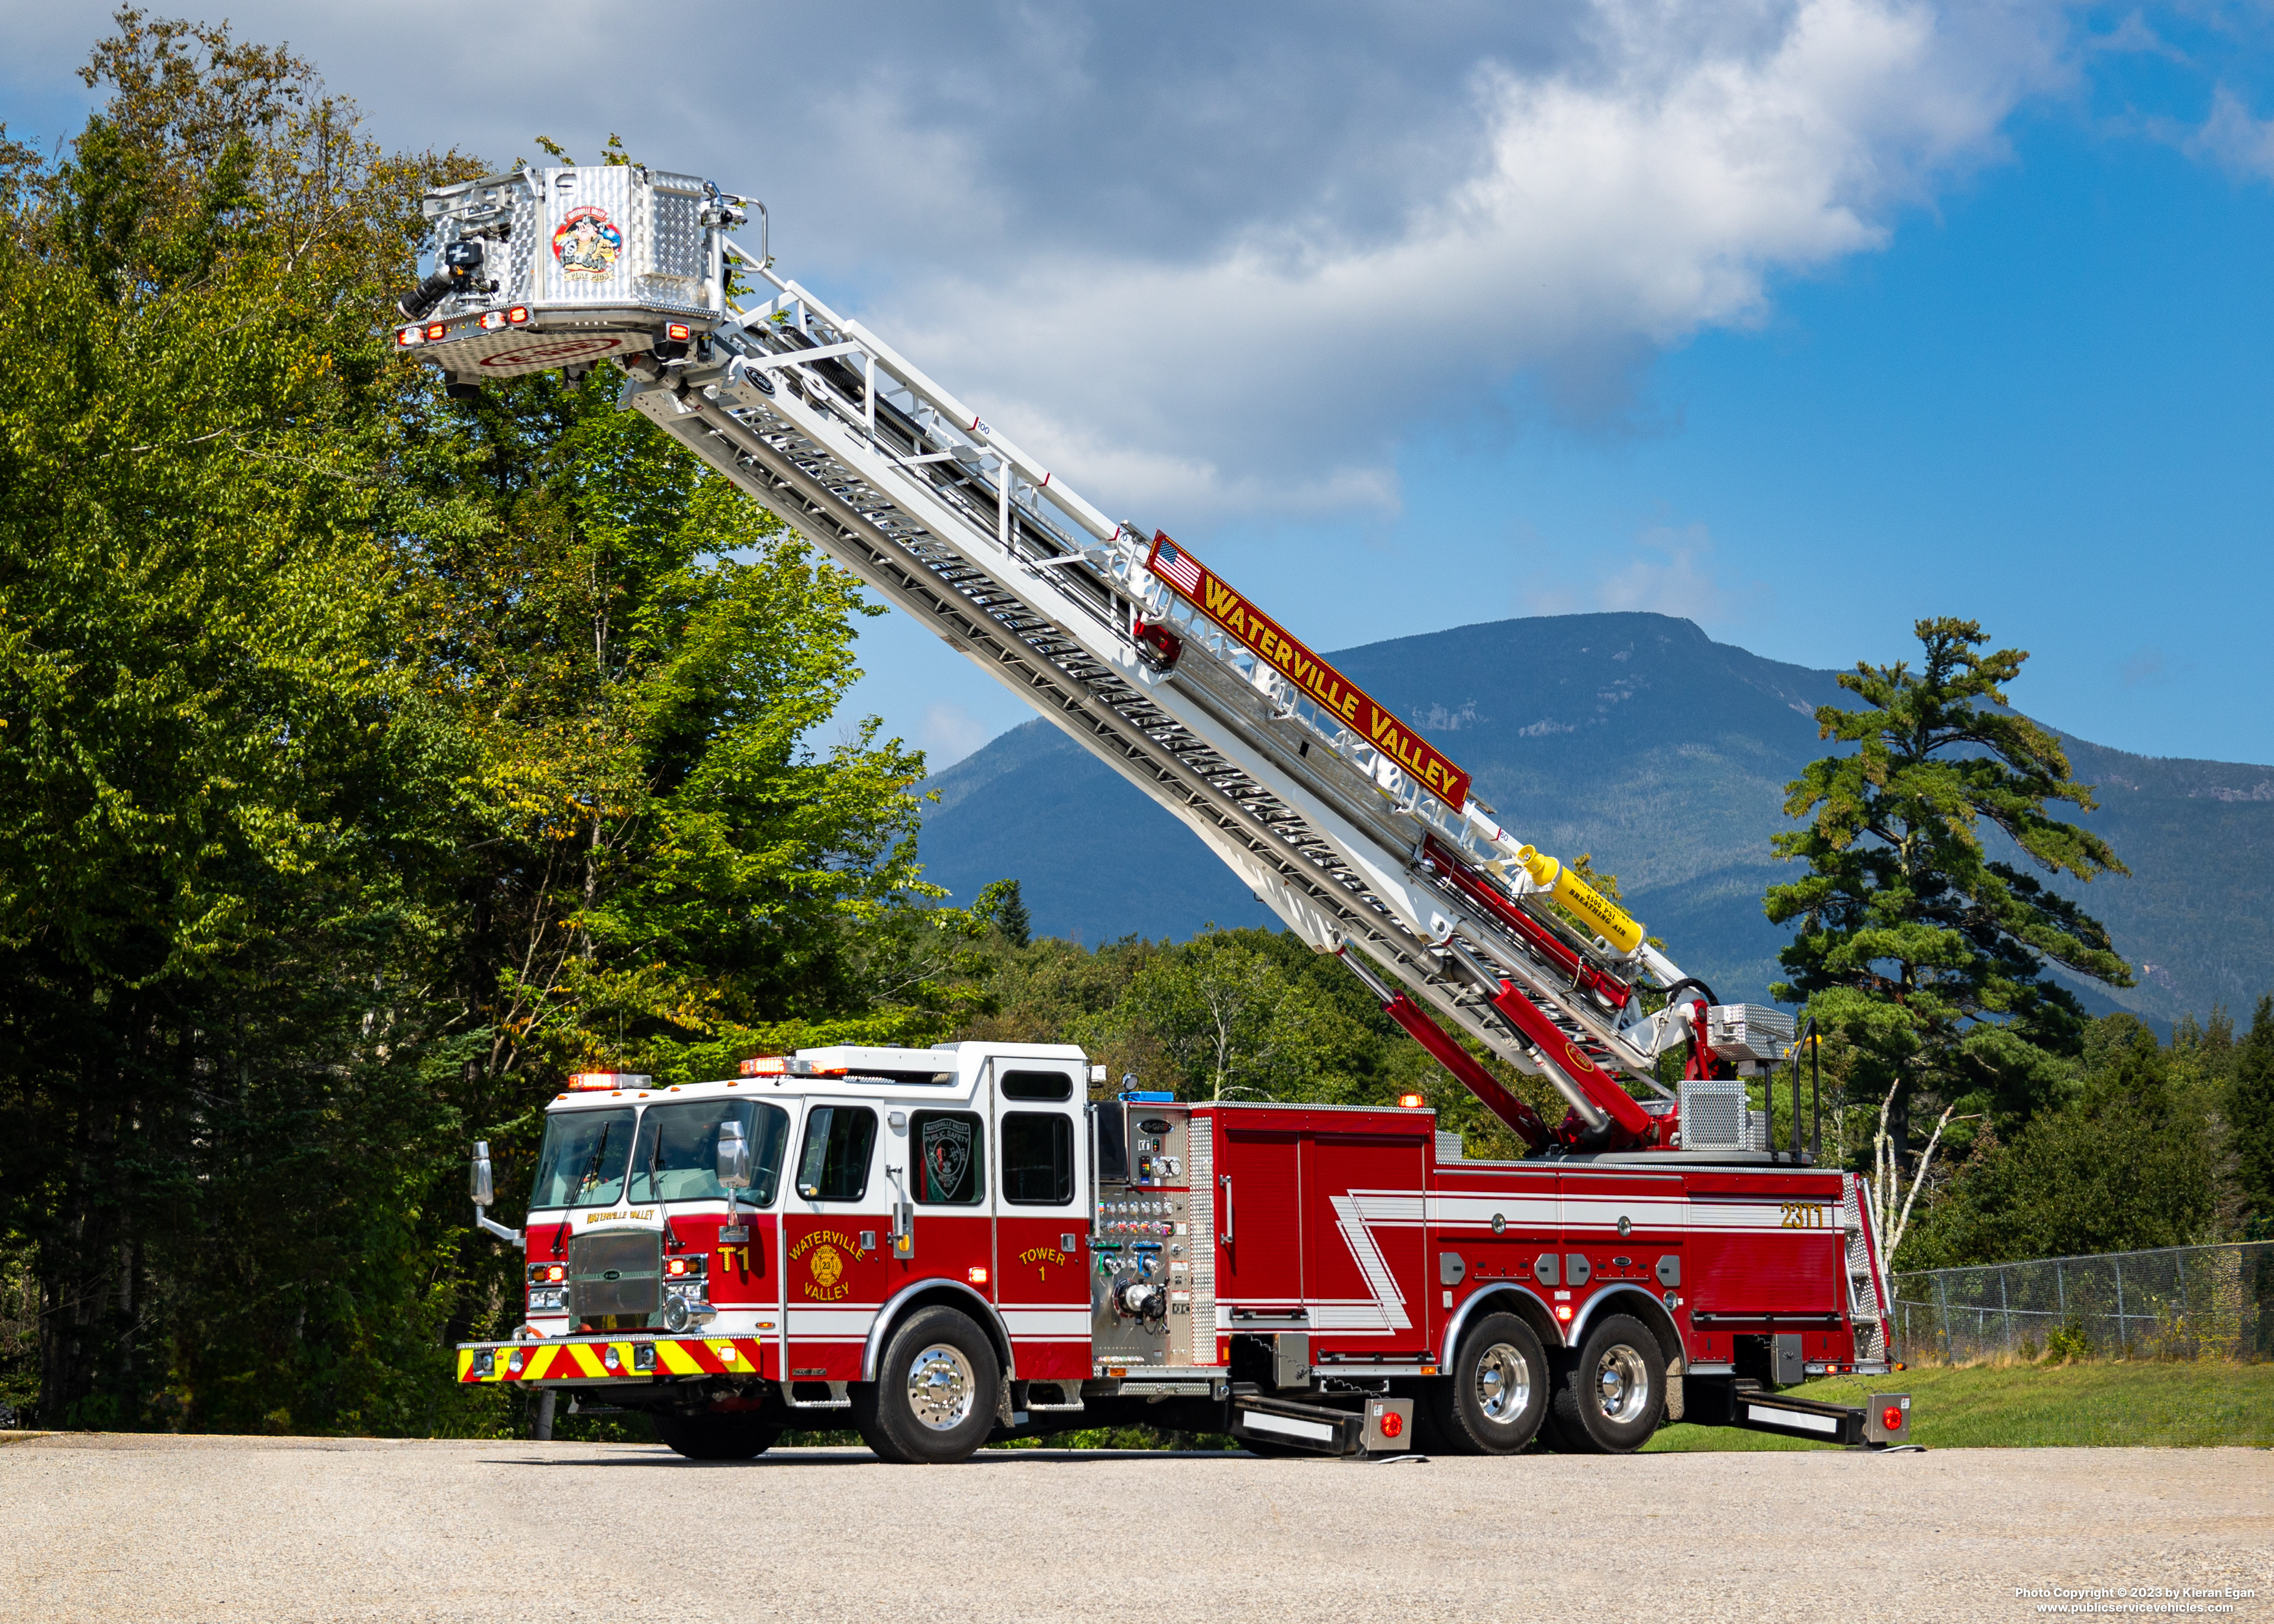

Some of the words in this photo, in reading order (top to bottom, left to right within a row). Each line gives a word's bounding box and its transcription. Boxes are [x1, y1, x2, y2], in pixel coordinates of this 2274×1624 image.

[591, 208, 607, 218] VALLEY
[571, 273, 588, 281] FIRE
[591, 272, 609, 281] PIGS
[503, 342, 599, 363] E-ONE
[751, 371, 771, 389] E-ONE
[978, 421, 990, 434] 100
[1204, 573, 1360, 721] WATERVILLE
[1371, 705, 1458, 796] VALLEY
[1500, 831, 1509, 842] 60
[1574, 876, 1592, 894] HIGH
[1595, 892, 1631, 925] PRESSURE
[1586, 894, 1602, 909] 4500
[1604, 906, 1616, 920] PSI
[1568, 888, 1612, 924] BREATHING
[1612, 922, 1627, 937] AIR
[1569, 1046, 1590, 1068] E-ONE
[926, 1121, 952, 1132] WATERVILLE
[952, 1122, 968, 1132] VALLEY
[1144, 1122, 1168, 1131] E-ONE
[925, 1131, 946, 1143] PUBLIC
[946, 1130, 969, 1143] SAFETY
[938, 1174, 958, 1182] MEDICAL
[587, 1210, 627, 1225] WATERVILLE
[630, 1209, 655, 1221] VALLEY
[1780, 1201, 1824, 1229] 23T1
[788, 1229, 866, 1262] WATERVILLE
[717, 1246, 749, 1273] T1
[822, 1261, 831, 1269] 23
[1019, 1246, 1065, 1268] TOWER
[1038, 1265, 1045, 1282] 1
[804, 1281, 849, 1301] VALLEY
